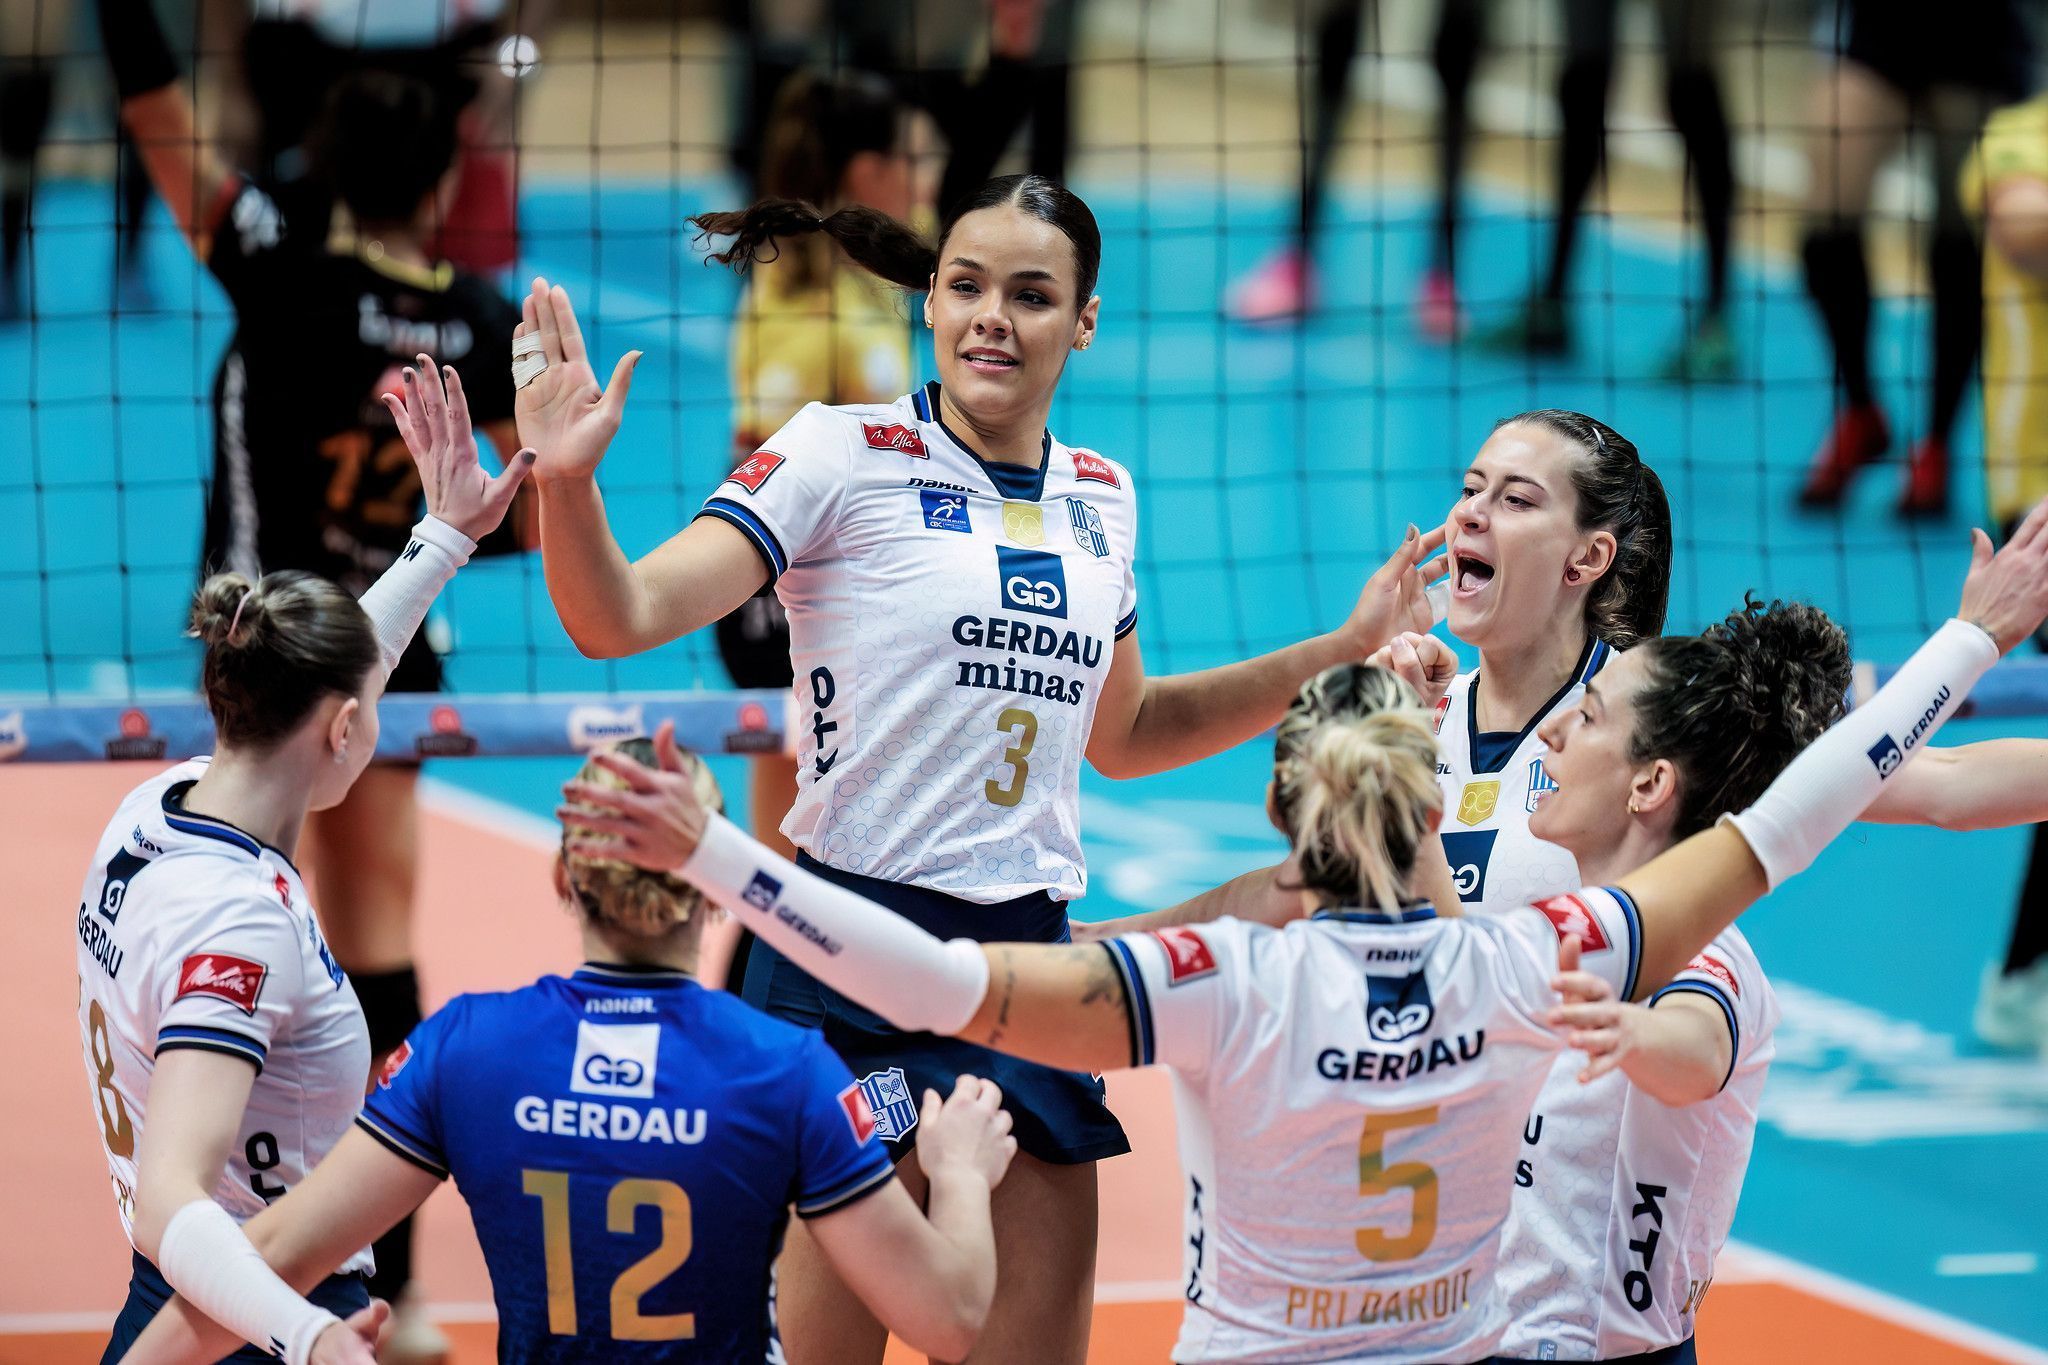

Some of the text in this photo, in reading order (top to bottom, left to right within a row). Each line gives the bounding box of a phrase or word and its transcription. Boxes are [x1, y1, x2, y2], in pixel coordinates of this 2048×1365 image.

[951, 614, 1103, 669] GERDAU
[955, 657, 1085, 707] minas
[1903, 685, 1951, 751] GERDAU
[983, 708, 1038, 807] 3
[78, 902, 124, 979] GERDAU
[1317, 1030, 1485, 1082] GERDAU
[514, 1096, 708, 1144] GERDAU
[1355, 1104, 1440, 1263] 5
[522, 1168, 695, 1342] 12
[1623, 1181, 1668, 1312] KTO
[1286, 1268, 1472, 1330] PRI DAROIT
